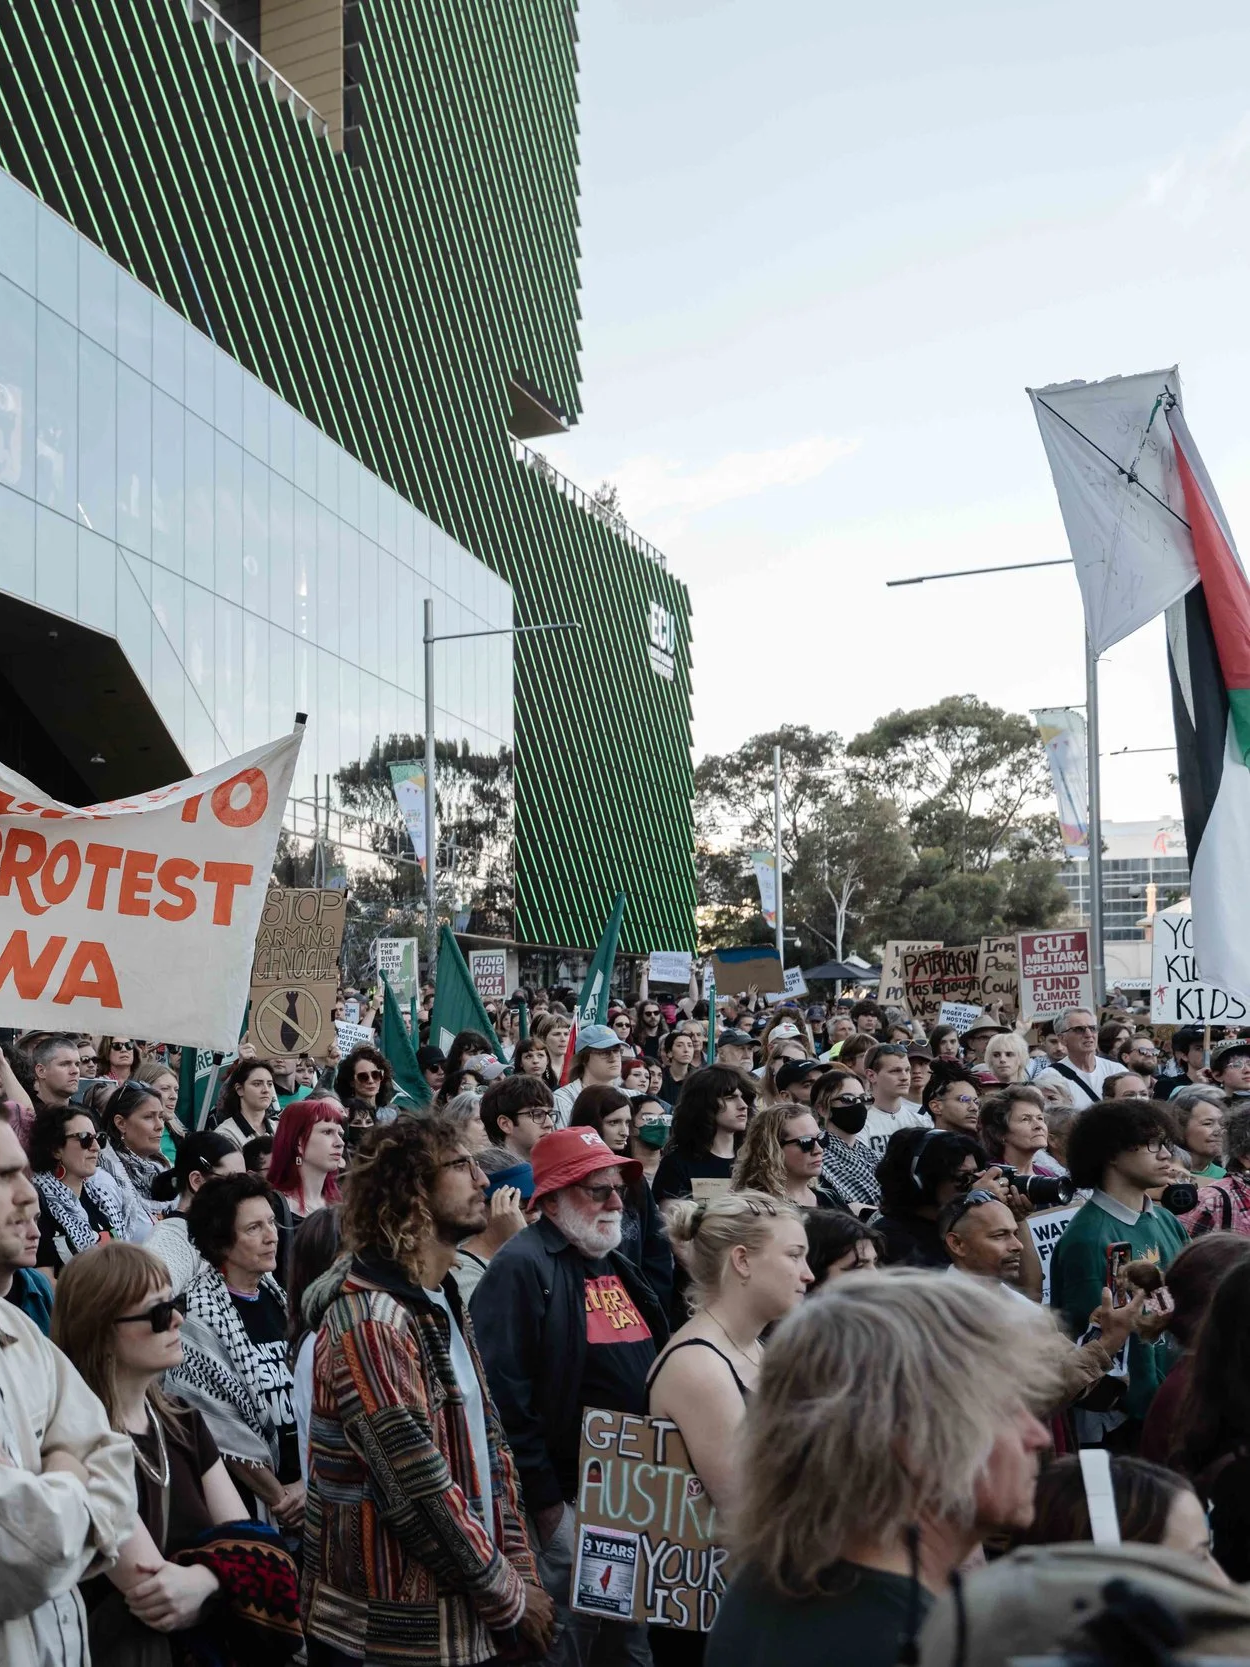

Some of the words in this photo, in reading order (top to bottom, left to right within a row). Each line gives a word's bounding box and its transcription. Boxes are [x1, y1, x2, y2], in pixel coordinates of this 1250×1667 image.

[650, 601, 675, 654] ECU
[261, 888, 343, 926] STOP
[257, 925, 336, 947] ARMING
[1033, 935, 1074, 953] CUT
[255, 947, 340, 981] GENOCIDE
[473, 956, 504, 966] FUND
[1026, 950, 1084, 965] MILITARY
[474, 965, 504, 976] NDIS
[786, 972, 800, 980] SIDE
[1023, 961, 1088, 976] SPENDING
[477, 976, 502, 986] NOT
[1033, 976, 1080, 992] FUND
[477, 986, 502, 995] WAR
[1032, 990, 1081, 1002] CLIMATE
[1176, 988, 1247, 1020] KIDS
[354, 1031, 370, 1040] COOK
[584, 1410, 679, 1463] GET
[580, 1456, 717, 1539] AUSTR
[584, 1539, 592, 1551] 3
[595, 1540, 636, 1559] YEARS
[646, 1587, 688, 1628] IS
